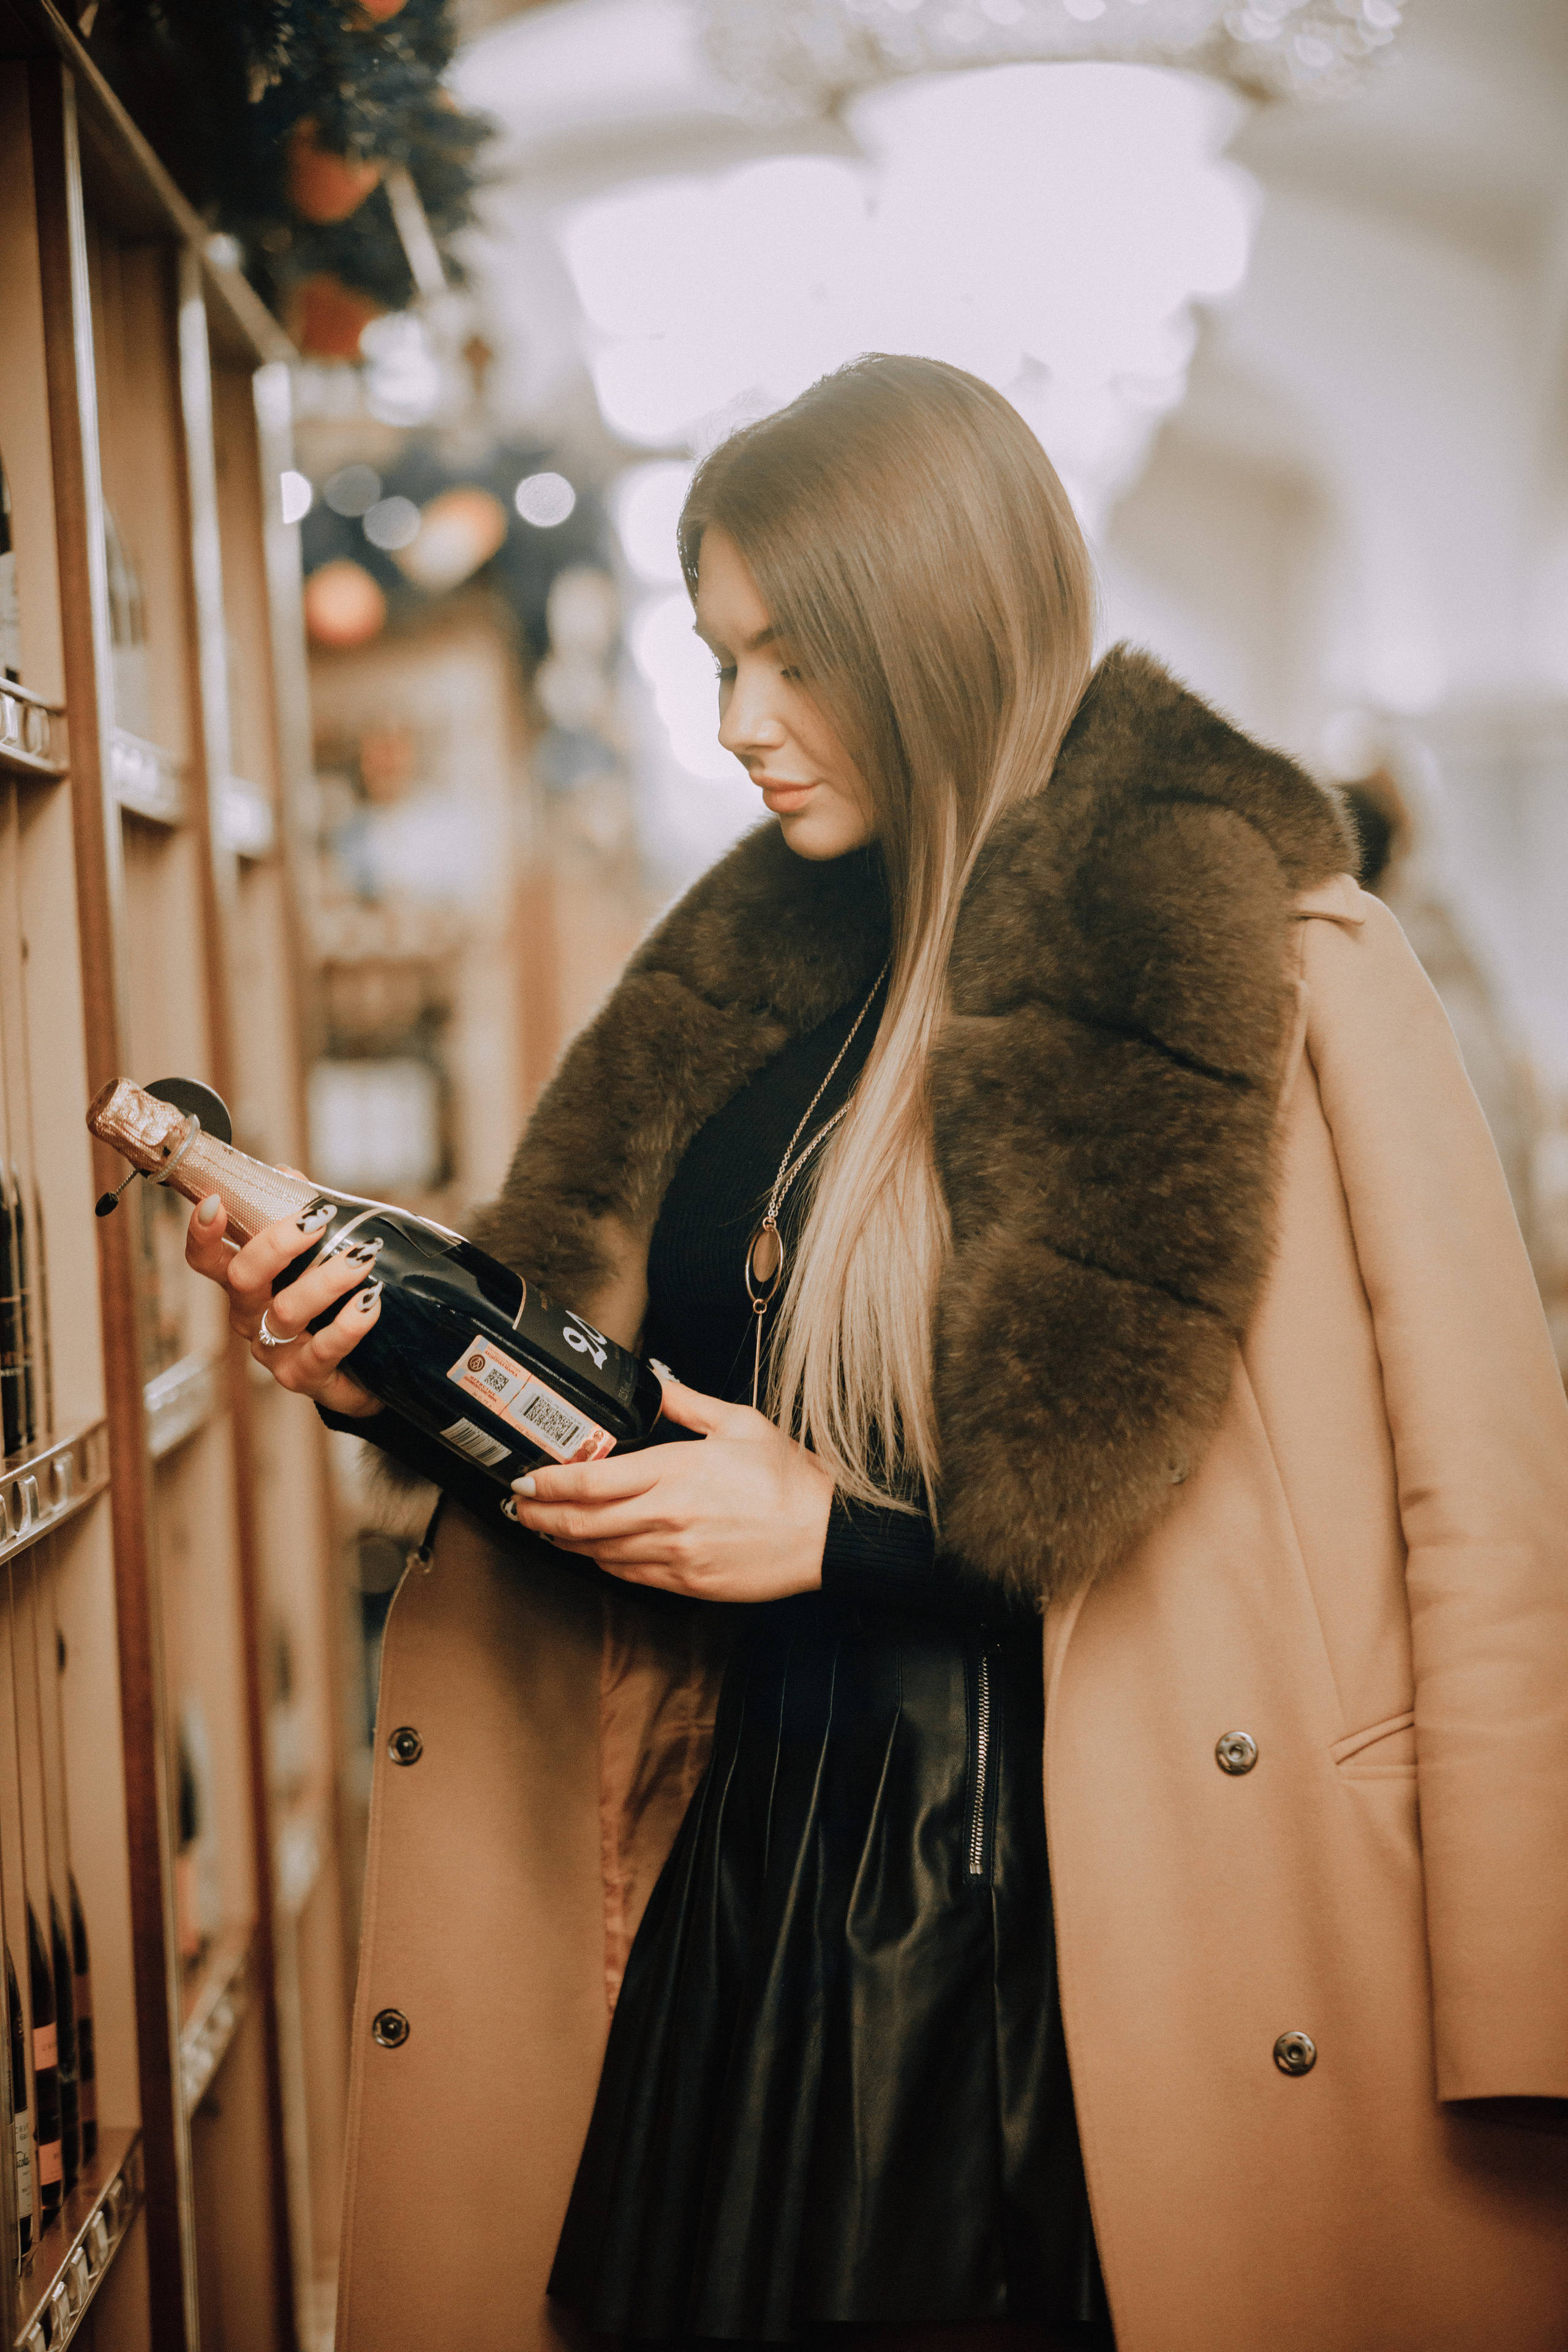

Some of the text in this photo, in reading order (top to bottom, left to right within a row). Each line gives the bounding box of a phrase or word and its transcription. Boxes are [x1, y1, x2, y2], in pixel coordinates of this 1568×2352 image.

[484, 1349, 518, 1378] АКЦИЗНАЯ МАРКА
[470, 1375, 496, 1397] ИГРИСТЫЕ
